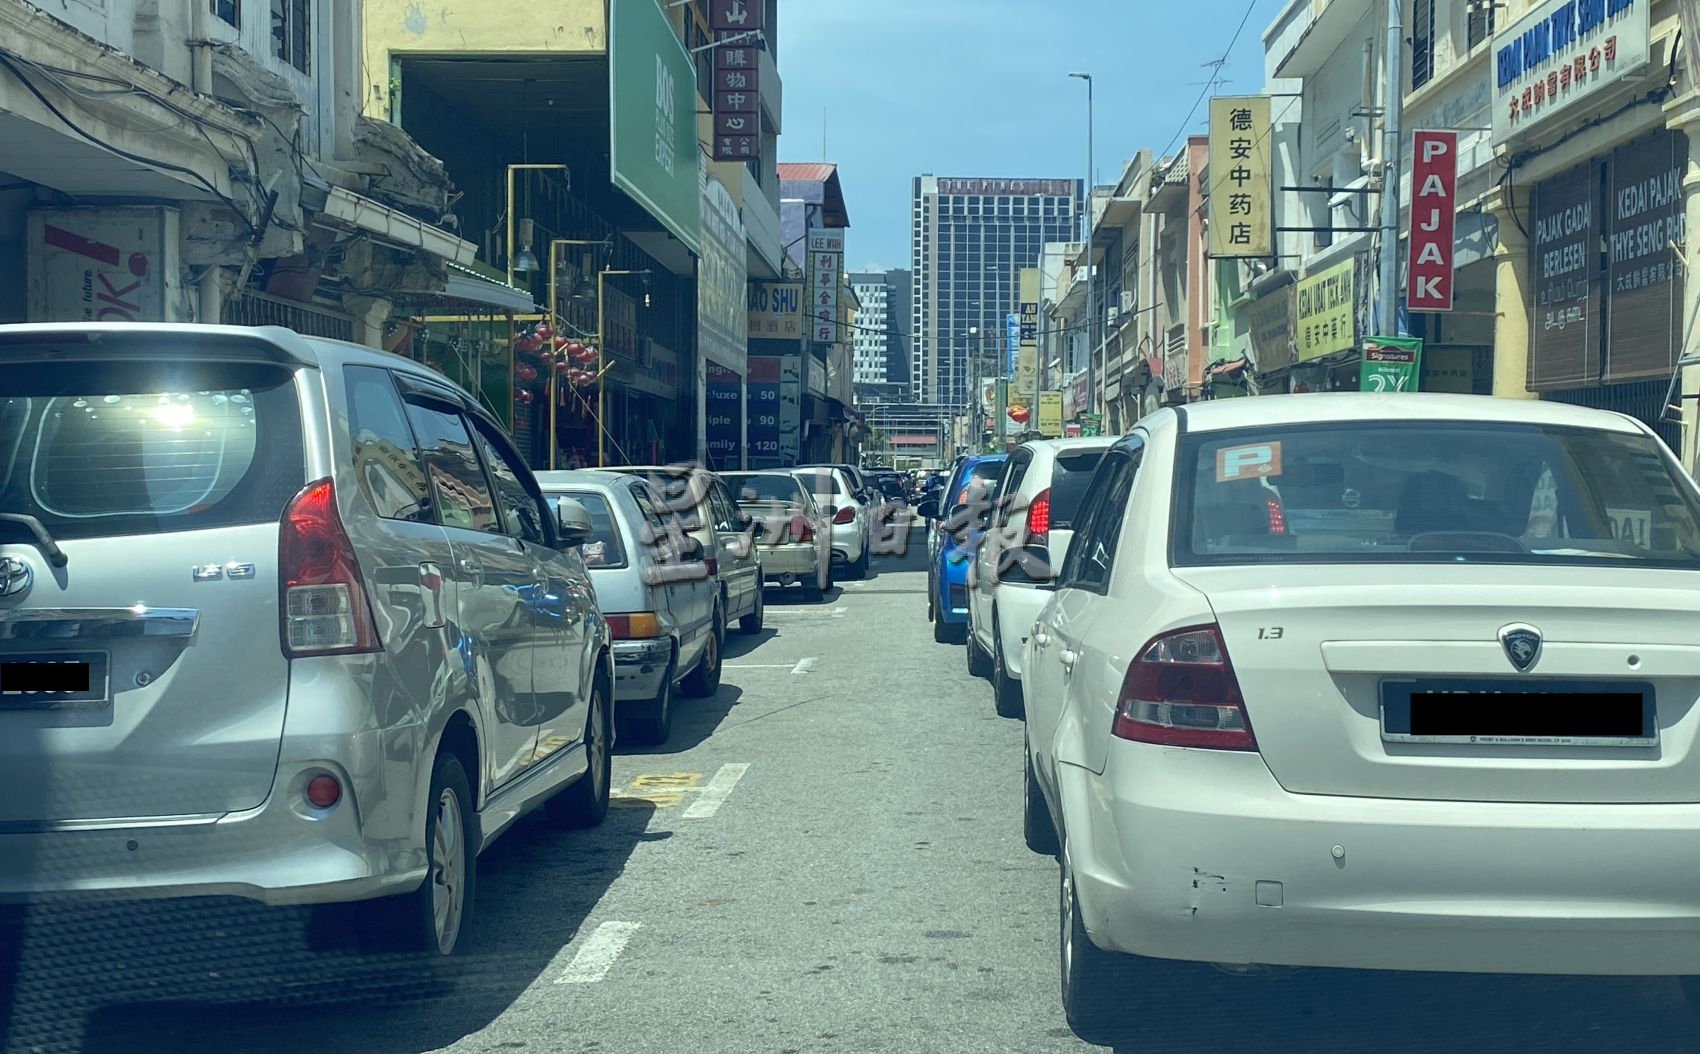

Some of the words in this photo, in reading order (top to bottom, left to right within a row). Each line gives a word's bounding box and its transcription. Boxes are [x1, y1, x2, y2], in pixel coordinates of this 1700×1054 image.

[655, 52, 675, 125] BOS
[725, 49, 748, 130] 購物中心
[947, 180, 973, 190] THE
[982, 181, 1025, 190] PINES
[1229, 108, 1253, 245] 德安中药店
[1618, 180, 1648, 220] KEDAI
[1650, 166, 1682, 209] PAJAK
[1416, 140, 1448, 299] PAJAK
[1537, 211, 1563, 245] PAJAK
[1564, 199, 1592, 235] GADAI
[811, 237, 825, 249] LEE
[1610, 229, 1635, 263] THYE
[1637, 219, 1664, 257] SENG
[1667, 212, 1686, 248] BHD
[1543, 240, 1585, 279] BERLESEN
[771, 288, 799, 312] SHU
[708, 390, 738, 400] luxe
[760, 390, 775, 400] 50
[707, 415, 731, 427] iple
[759, 415, 775, 425] 90
[707, 439, 736, 451] mily
[755, 441, 778, 451] 120
[1224, 446, 1272, 478] P
[1258, 626, 1284, 639] 1.3
